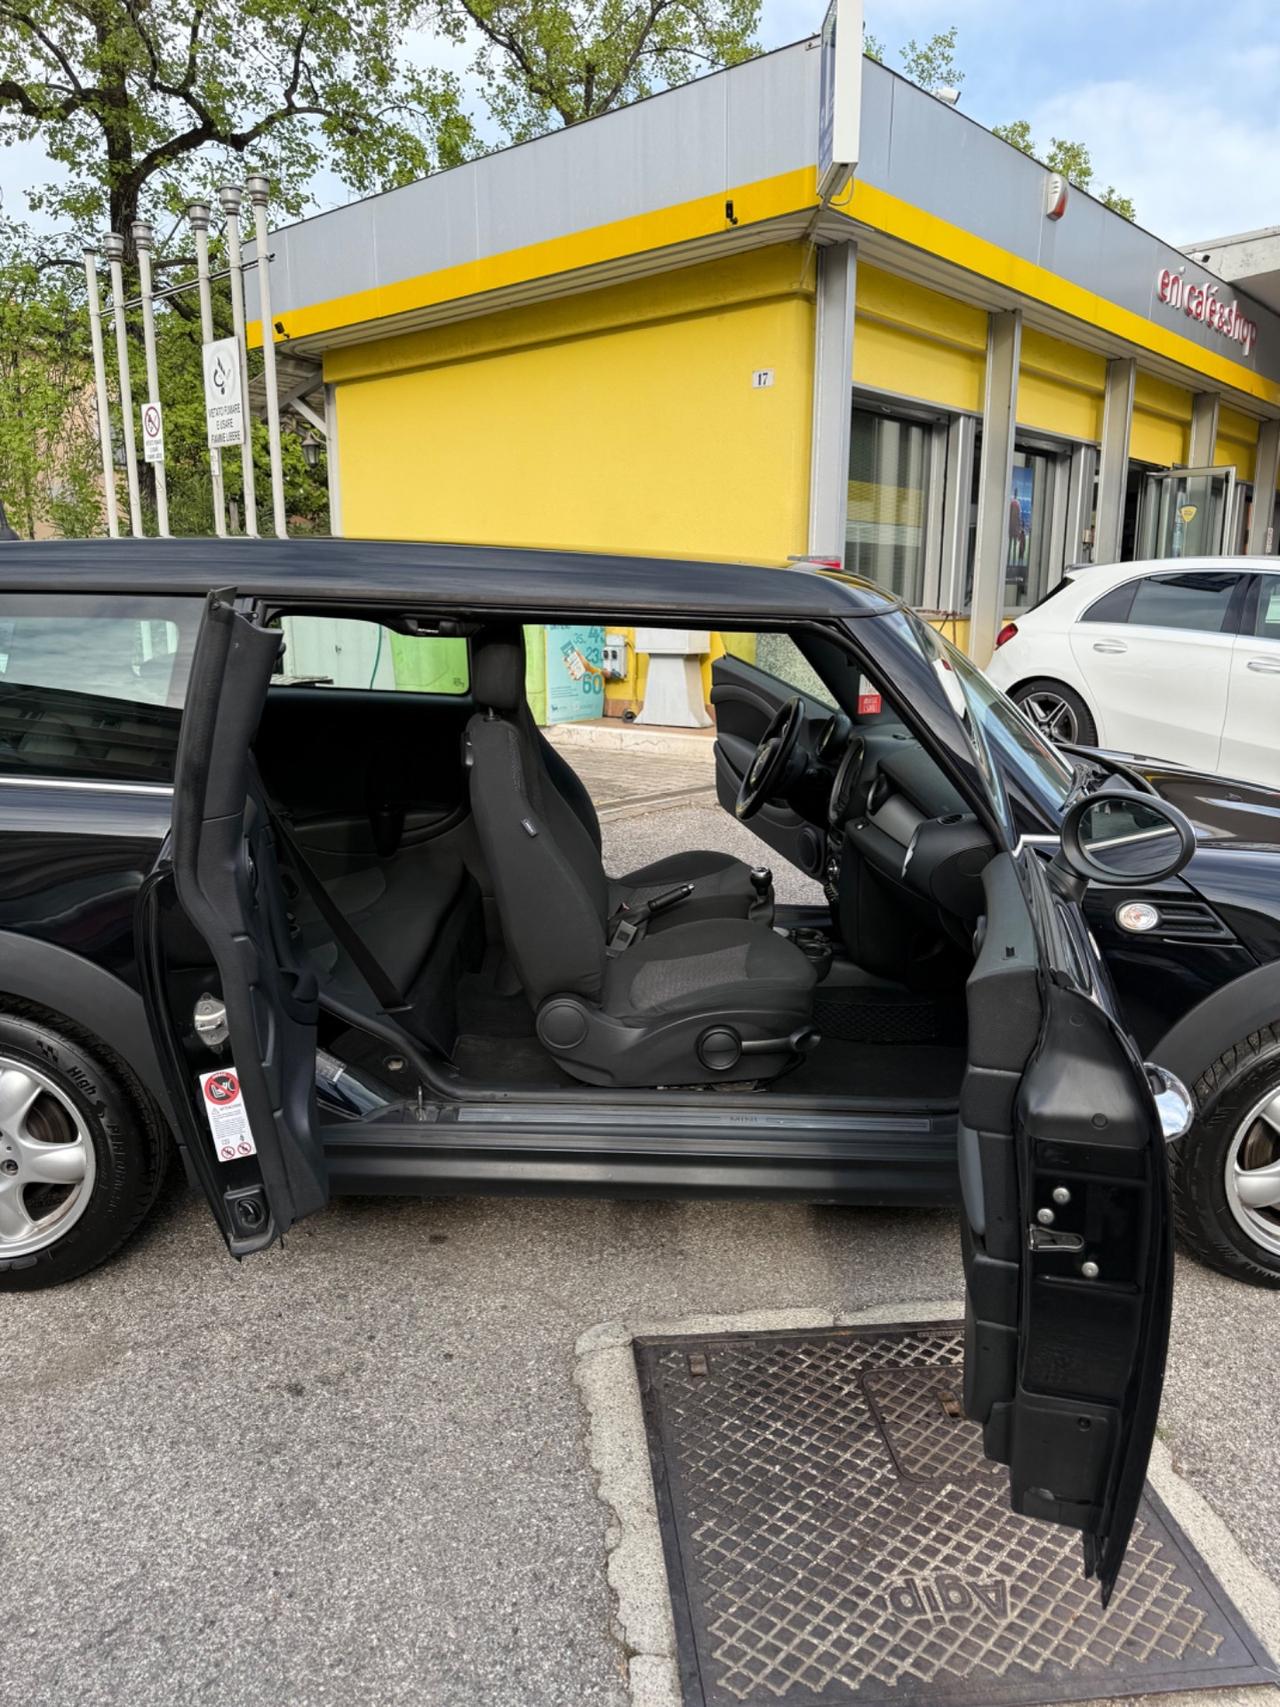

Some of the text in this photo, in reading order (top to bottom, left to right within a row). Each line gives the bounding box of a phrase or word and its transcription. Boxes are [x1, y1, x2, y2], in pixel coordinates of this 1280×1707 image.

[758, 371, 769, 386] 17
[583, 672, 602, 694] 60
[66, 1065, 98, 1097] High
[888, 1574, 1008, 1622] Agip
